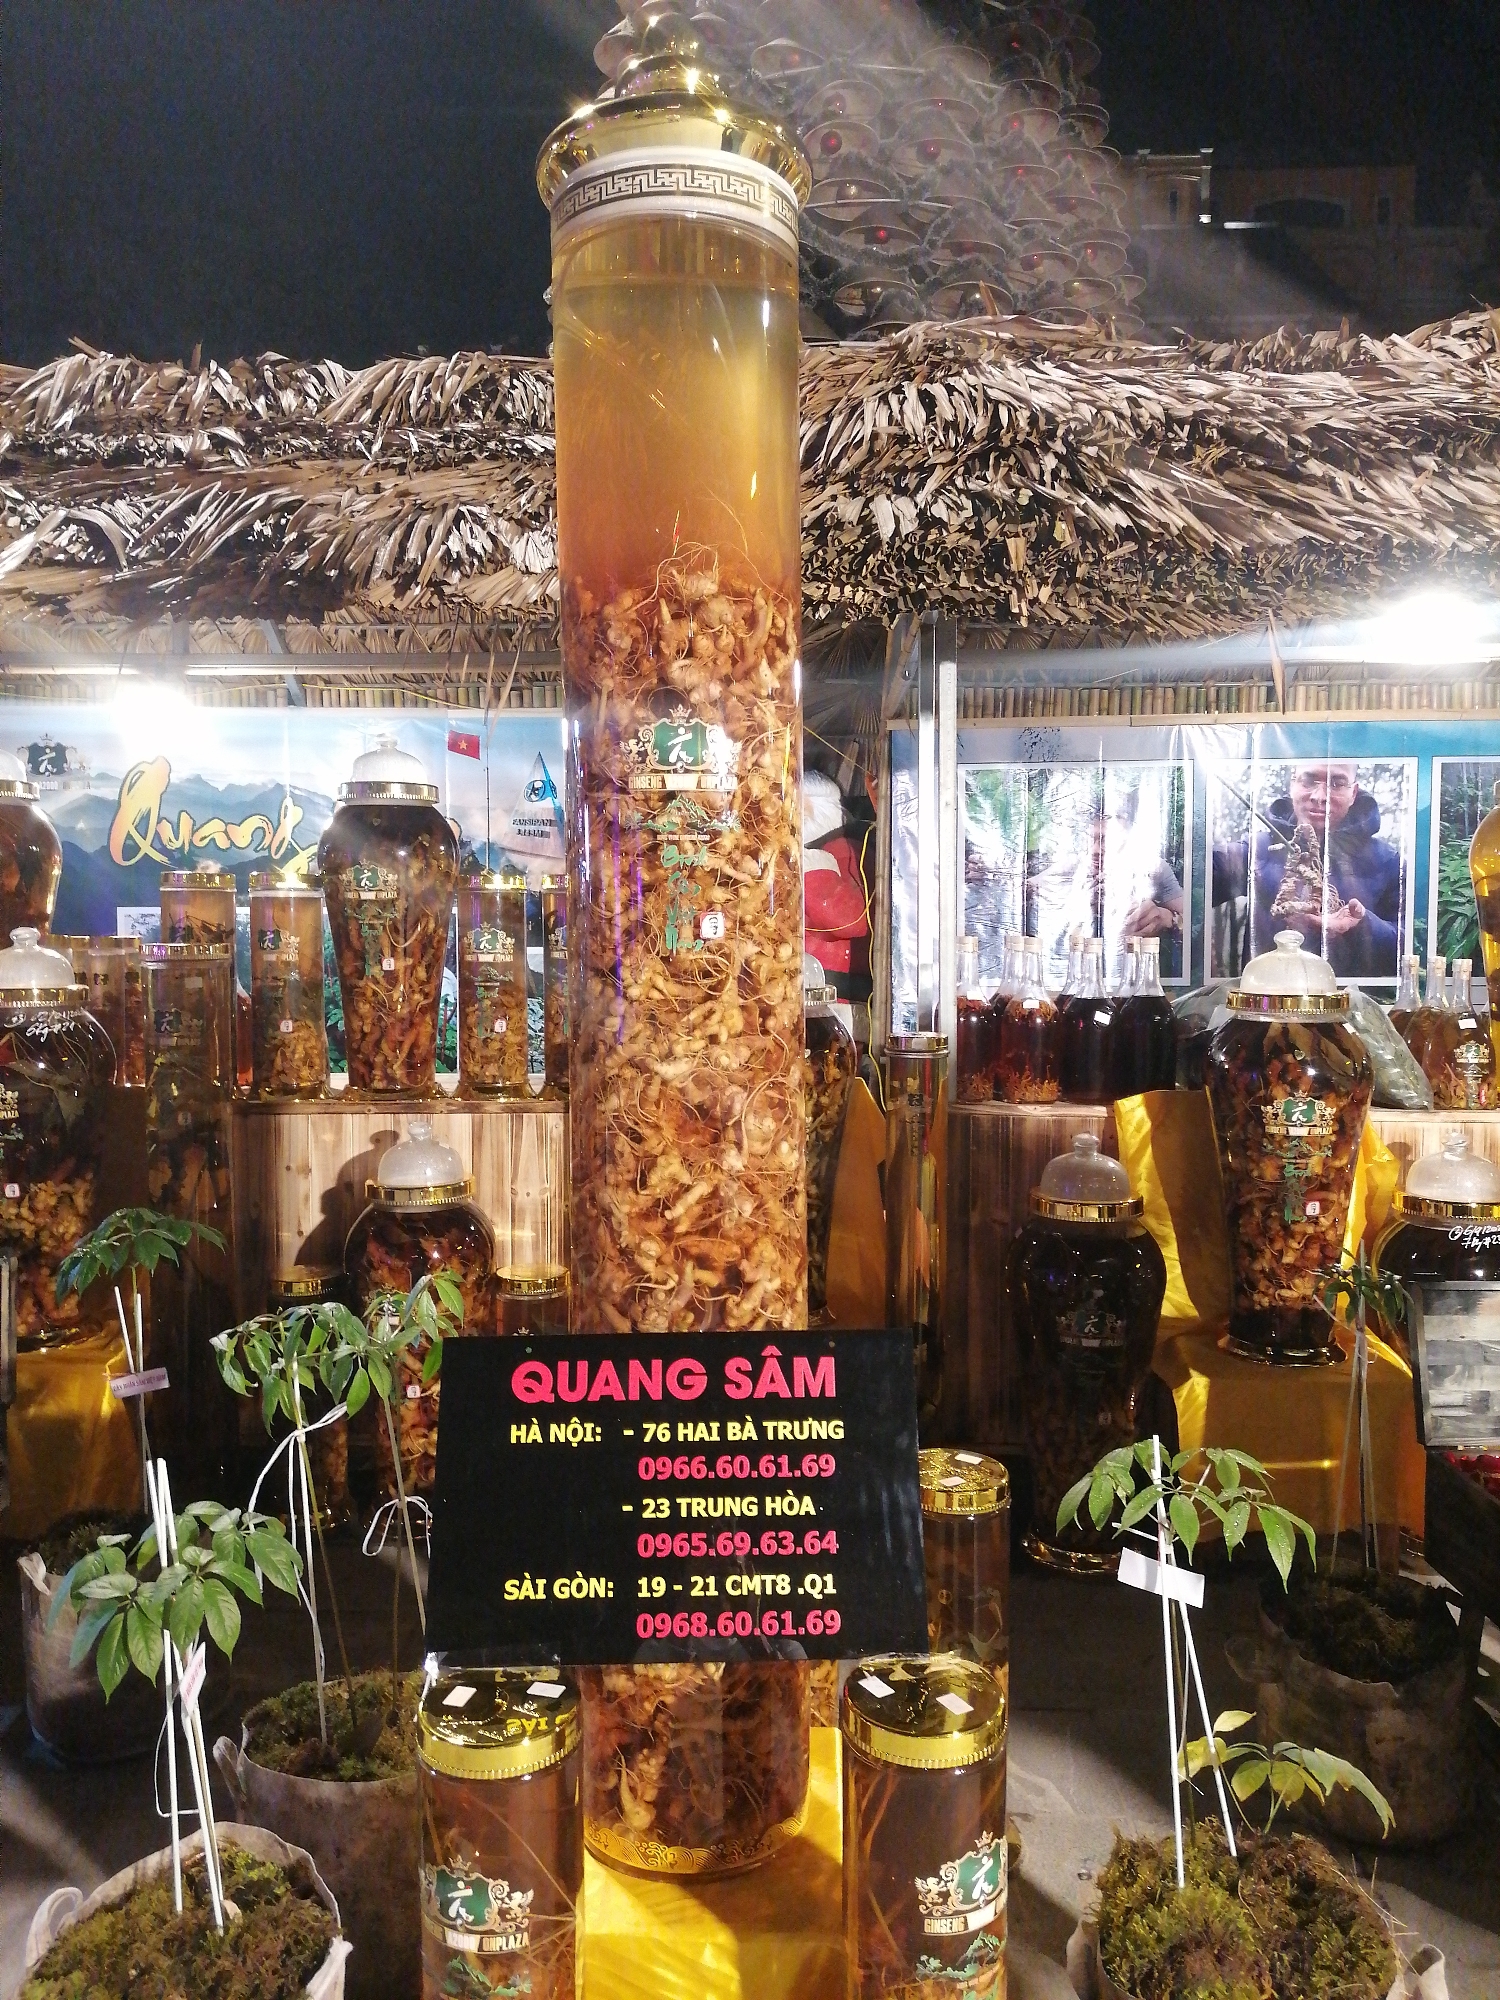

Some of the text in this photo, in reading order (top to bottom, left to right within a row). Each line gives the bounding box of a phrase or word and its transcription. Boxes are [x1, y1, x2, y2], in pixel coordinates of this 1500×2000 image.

[628, 775, 663, 789] GINSENG
[511, 1345, 837, 1404] QUANG SÂM
[510, 1418, 543, 1444] HÀ
[549, 1417, 602, 1447] NỘI:
[642, 1422, 671, 1443] 76
[677, 1422, 720, 1442] HAI
[726, 1415, 759, 1441] BÀ
[762, 1417, 845, 1441] TRƯNG
[637, 1453, 836, 1481] 0966.60.61.69
[641, 1497, 671, 1519] 23
[675, 1496, 759, 1518] TRUNG
[764, 1489, 817, 1517] HÒA
[636, 1529, 840, 1559] 0965.69.63.64
[503, 1572, 547, 1601] SÀI
[552, 1571, 614, 1600] GÒN:
[637, 1576, 667, 1598] 19
[690, 1575, 719, 1597] 21
[725, 1574, 792, 1597] CMT8
[635, 1608, 842, 1639] 0968.60.61.69
[924, 1917, 965, 1934] GINSENG
[482, 1932, 530, 1952] ONPLAZA
